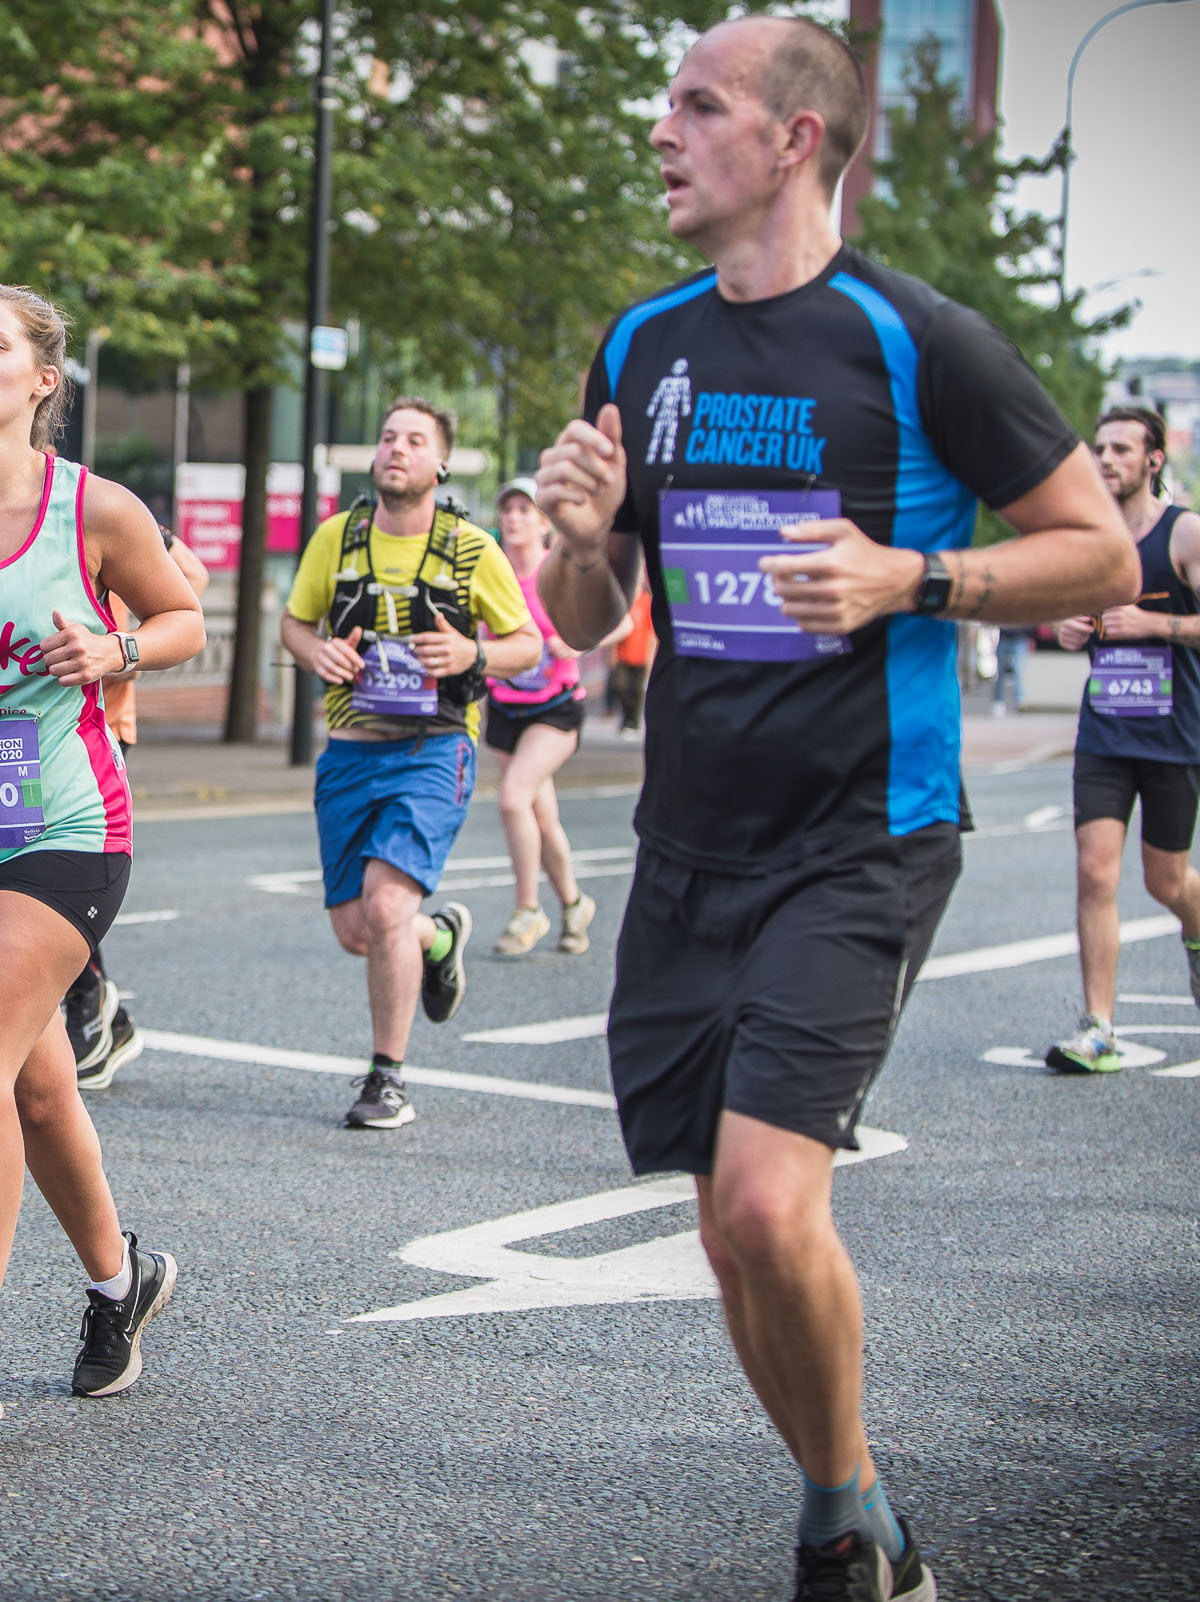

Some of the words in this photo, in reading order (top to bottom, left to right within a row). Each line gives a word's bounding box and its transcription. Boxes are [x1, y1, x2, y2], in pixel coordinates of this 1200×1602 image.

[693, 392, 816, 433] PROSTATE
[685, 428, 786, 467] CANCER
[786, 436, 826, 475] UK
[694, 570, 810, 607] 1278
[366, 672, 422, 691] 12290
[1108, 678, 1154, 696] 6743
[17, 766, 29, 777] M
